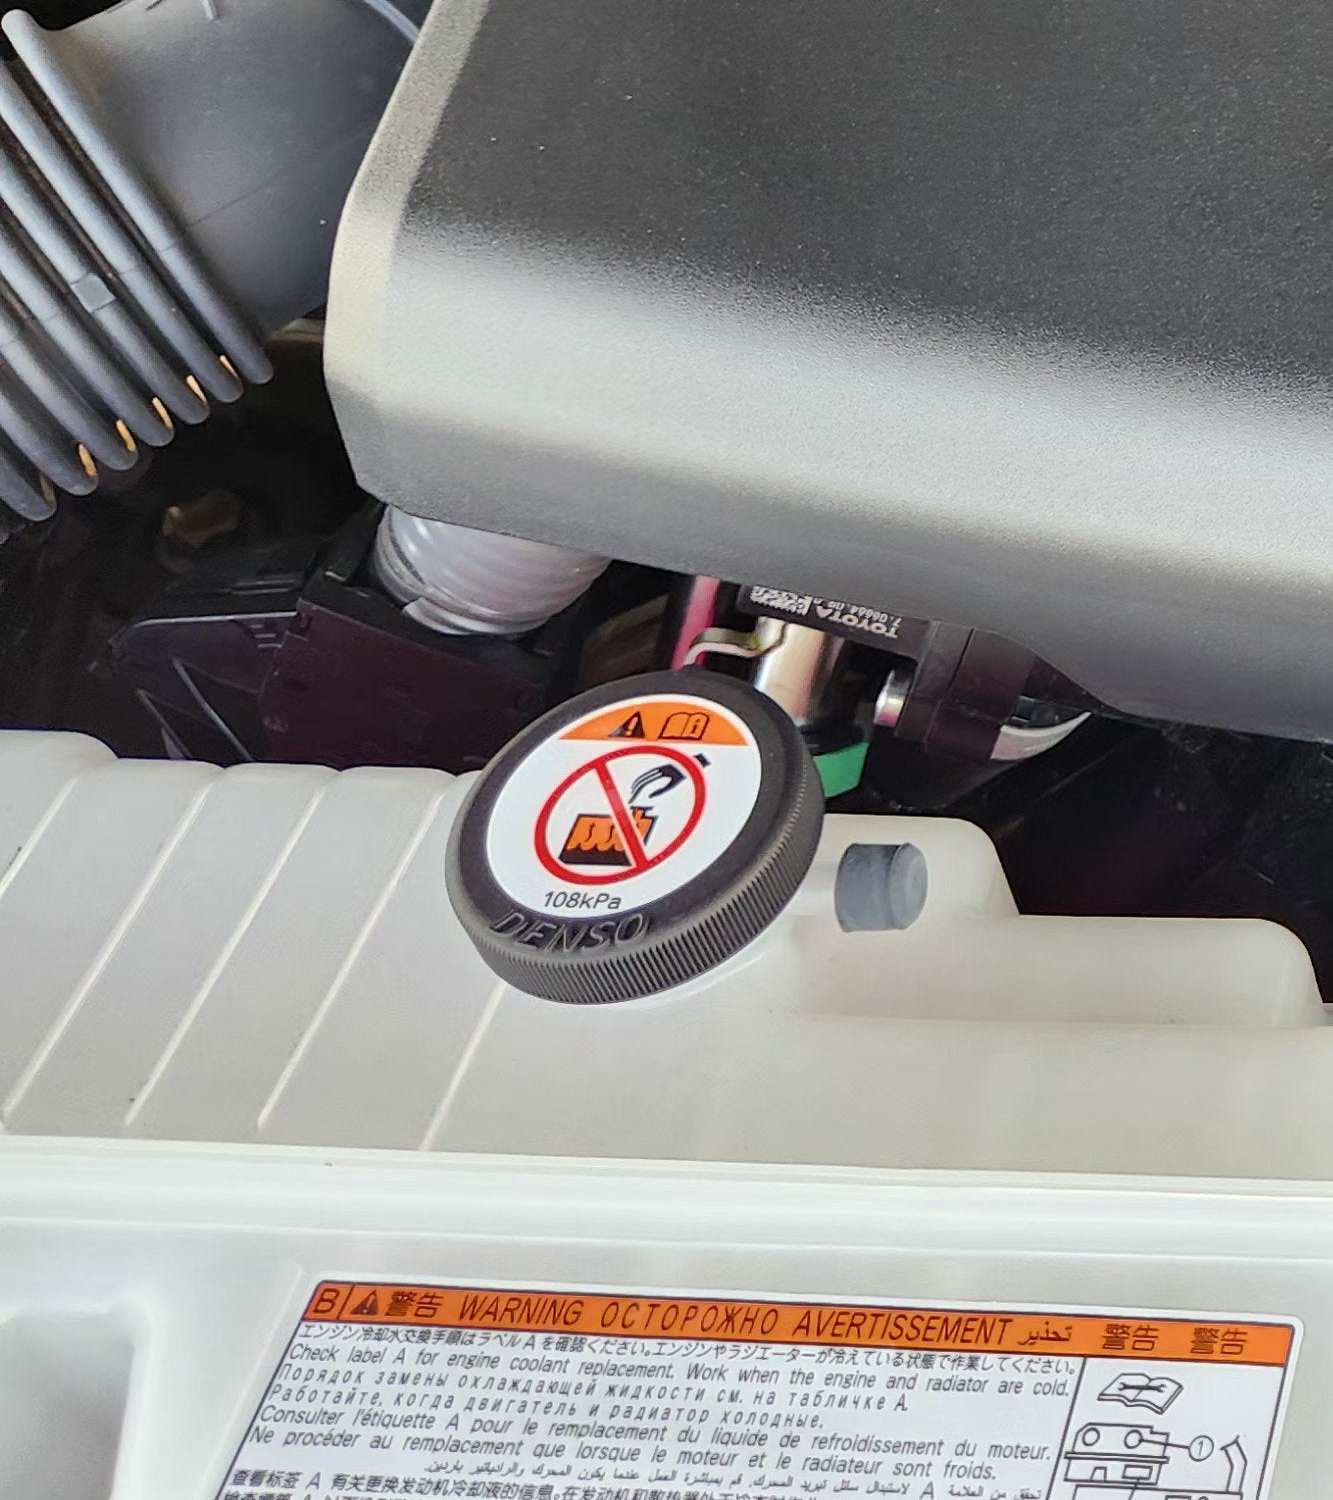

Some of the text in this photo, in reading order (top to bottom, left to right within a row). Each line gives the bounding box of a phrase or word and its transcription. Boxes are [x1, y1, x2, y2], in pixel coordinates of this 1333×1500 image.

[816, 605, 899, 639] TOYOTA
[544, 890, 621, 911] 108kPa
[489, 911, 651, 955] DENSO
[313, 1288, 341, 1315] B
[385, 1290, 1247, 1355] 警告 WARNING ОСТОРОЖНО AVERTISSEMENT تحذير 警告 警告
[279, 1363, 365, 1384] Порядок
[375, 1370, 448, 1387] замены
[457, 1375, 598, 1397] охлаждающей
[604, 1384, 706, 1402] жидкости
[717, 1388, 743, 1404] см.
[753, 1390, 776, 1406] на
[788, 1390, 887, 1410] табличке
[289, 1344, 1069, 1397] Check label A for engine coolant replacement. Work when the engine and radiator are cold.
[267, 1384, 824, 1430] Работайте, когда двигатель и радиатор холодные.
[250, 1425, 997, 1481] Ne procéder au remplacement que lorsque le moteur et le radiateur sont froids.
[260, 1405, 1051, 1461] Consulter l'étiquette A pour le remplacement du liquide de refroidissement du moteur.
[305, 1471, 321, 1490] A
[920, 1481, 935, 1500] A
